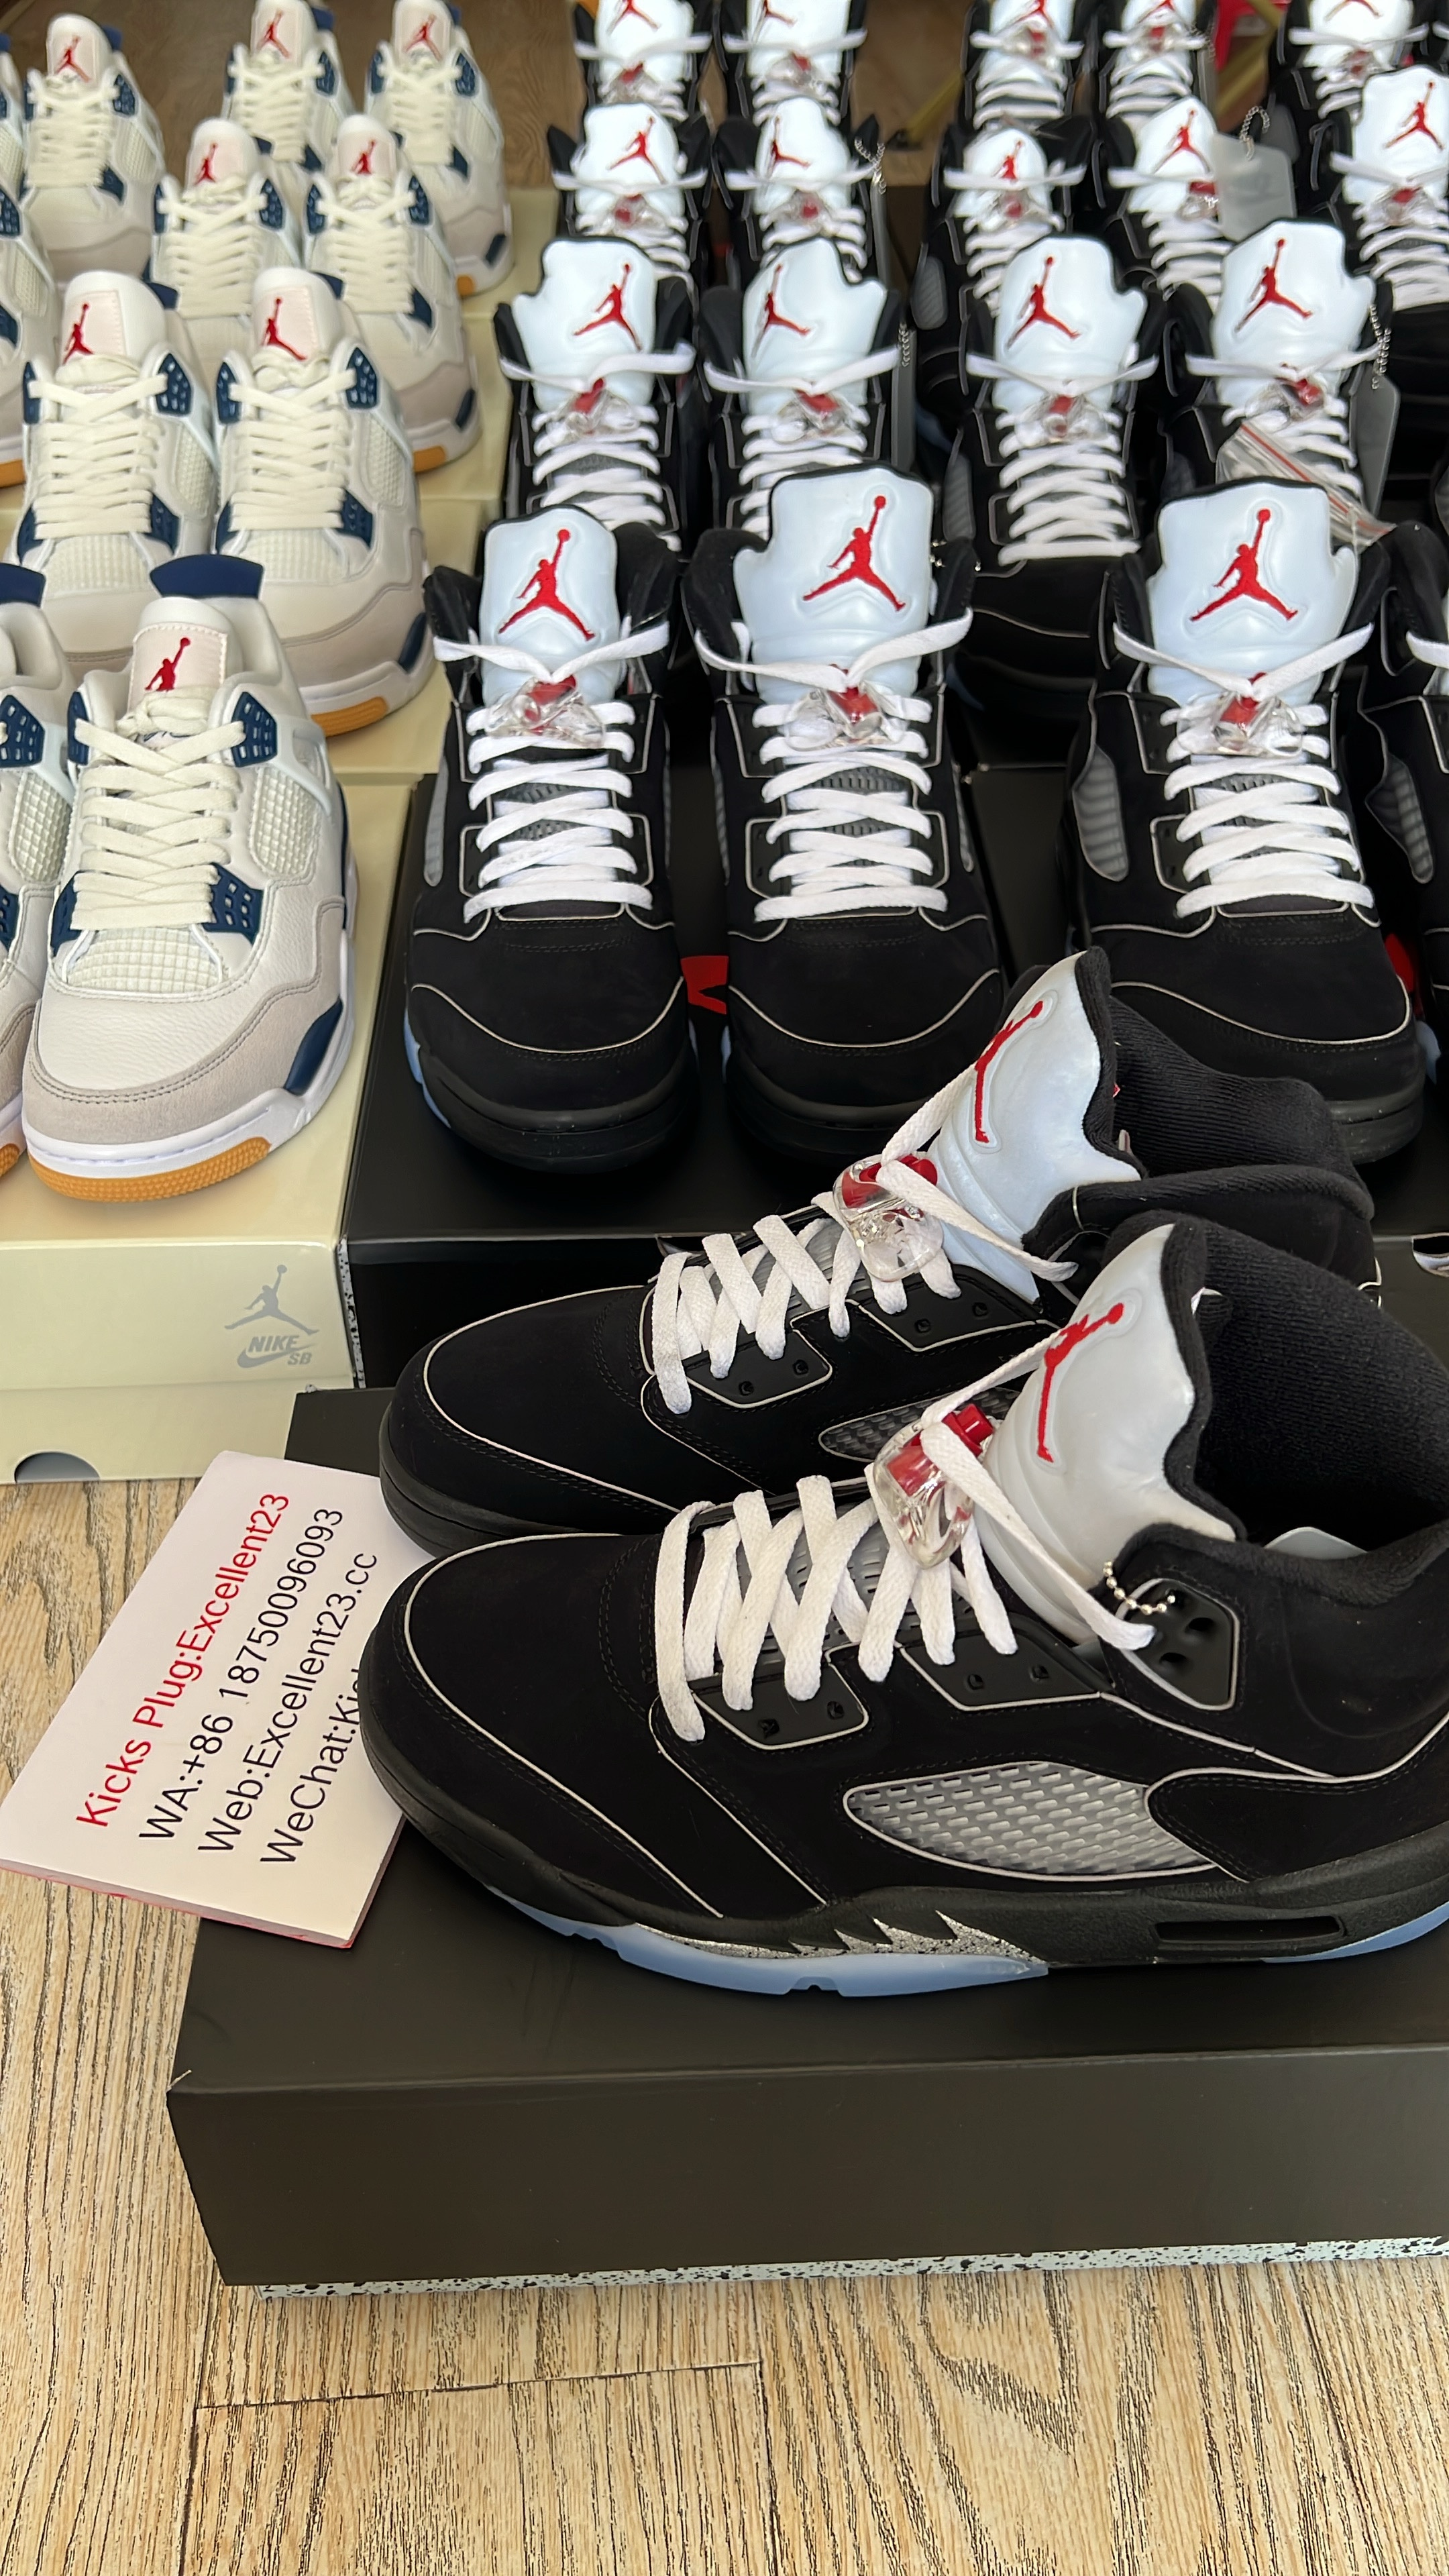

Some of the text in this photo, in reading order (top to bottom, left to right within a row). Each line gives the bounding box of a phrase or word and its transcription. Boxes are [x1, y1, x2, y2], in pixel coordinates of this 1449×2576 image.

[248, 1335, 299, 1353] NIKE
[287, 1352, 312, 1366] SB
[76, 1493, 290, 1827] Kicks Plug:Excellent23
[138, 1509, 343, 1837] WA:+86 18750096093
[197, 1553, 377, 1850] Web:Excellent23.cc
[260, 1668, 360, 1862] WeChat:Ki
